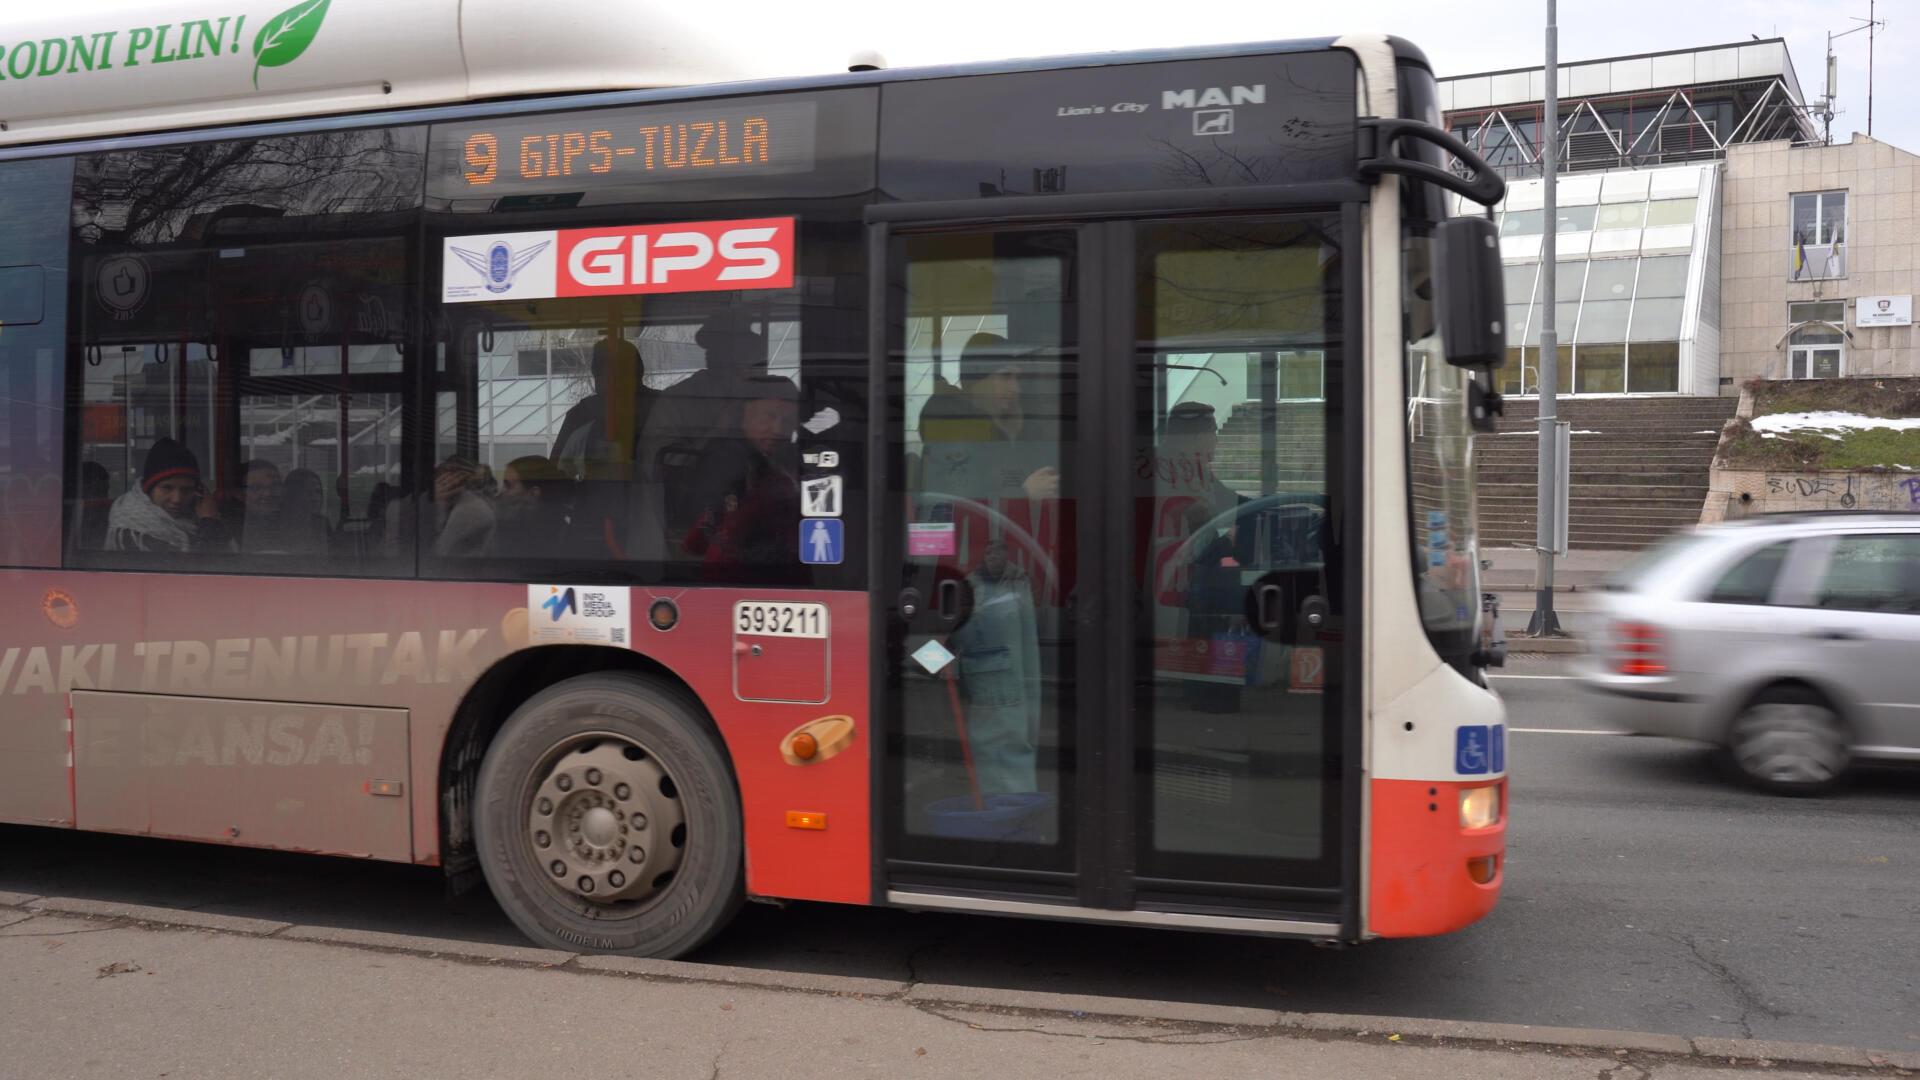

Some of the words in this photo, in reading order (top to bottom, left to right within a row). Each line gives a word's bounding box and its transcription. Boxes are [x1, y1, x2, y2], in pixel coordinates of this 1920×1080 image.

[0, 31, 118, 80] ODNI
[123, 14, 246, 67] PLIN!
[1056, 105, 1105, 116] Lion's
[1110, 102, 1149, 114] City
[1161, 84, 1266, 110] MAN
[464, 132, 498, 185] 9
[520, 116, 769, 179] GIPS-TUZLA
[568, 227, 781, 287] GIPS
[582, 593, 605, 601] INFO
[582, 601, 613, 609] MEDIA
[582, 609, 616, 618] GROUP
[740, 606, 820, 633] 593211
[134, 627, 489, 694] TRENUTAK
